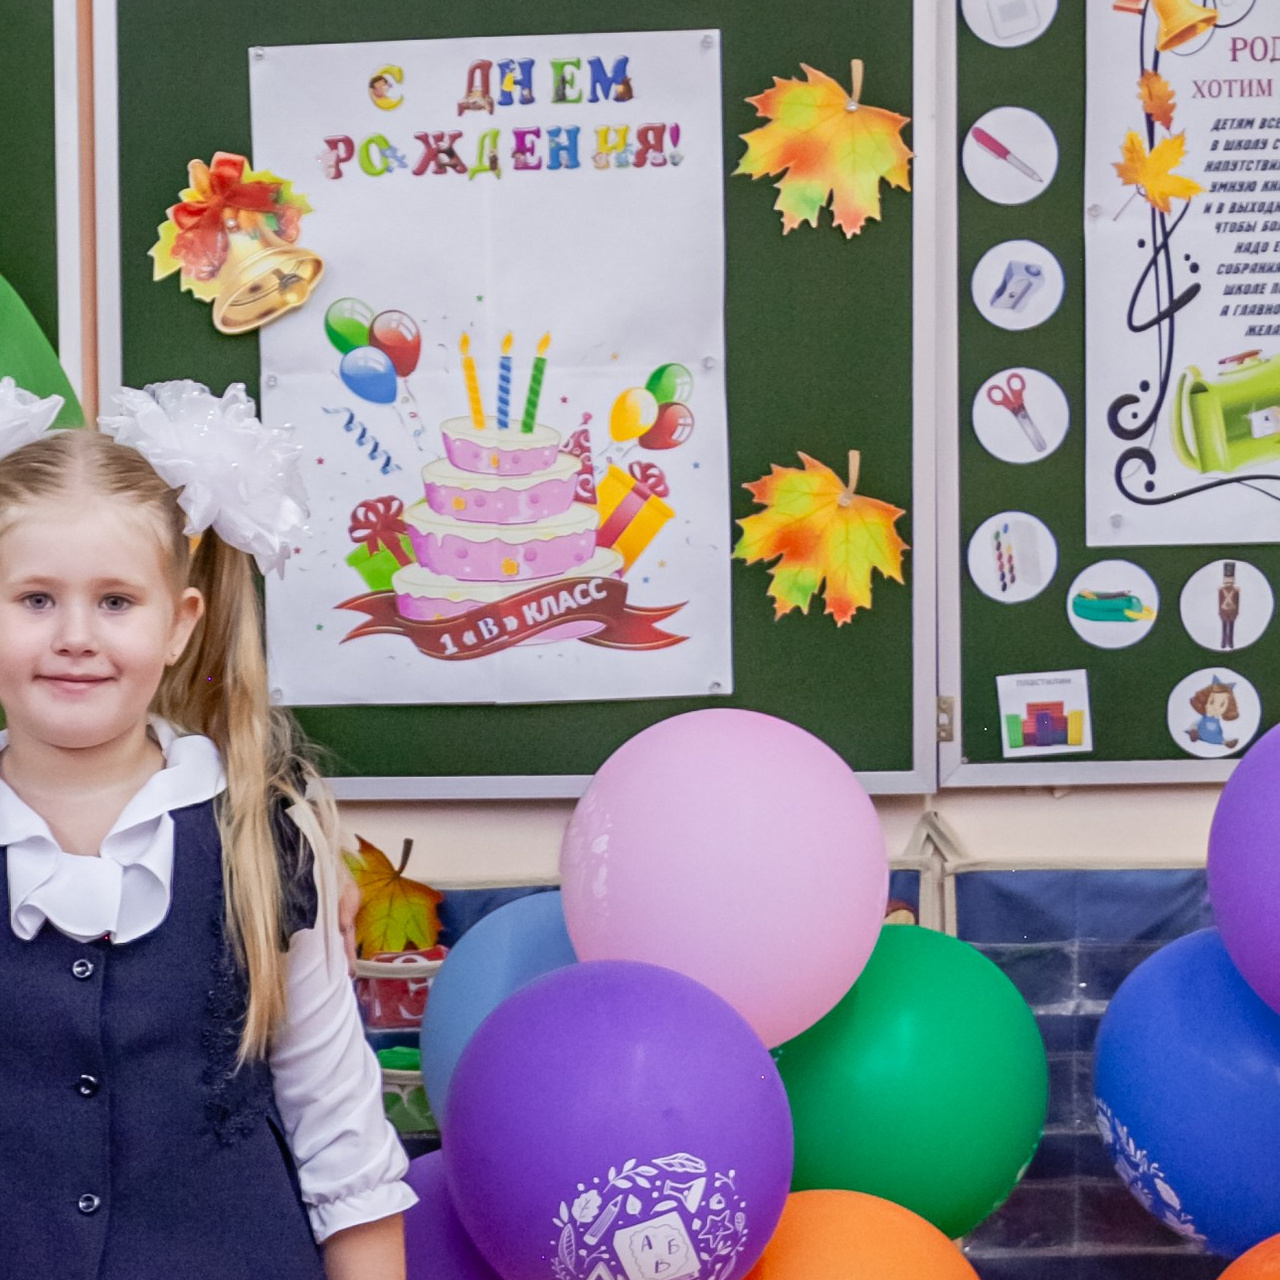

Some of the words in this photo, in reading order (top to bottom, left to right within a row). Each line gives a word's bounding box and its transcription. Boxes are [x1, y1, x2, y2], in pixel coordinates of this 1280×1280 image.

[368, 64, 404, 111] С
[457, 54, 635, 117] ДНЕМ
[1191, 78, 1273, 98] ХОТИМ
[1210, 118, 1256, 132] ДЕТЯМ
[318, 122, 683, 180] РОЖДЕНИЯ!
[1223, 138, 1269, 151] ШКОЛУ
[1203, 160, 1280, 172] НАПУТСТВИ
[1215, 221, 1258, 234] ЧТОБЫ
[1234, 241, 1269, 255] НАДО
[1223, 283, 1267, 296] ШКОЛЕ
[439, 633, 459, 655] 1
[522, 578, 607, 626] КЛАСС
[641, 1235, 652, 1252] А
[668, 1238, 679, 1254] Б
